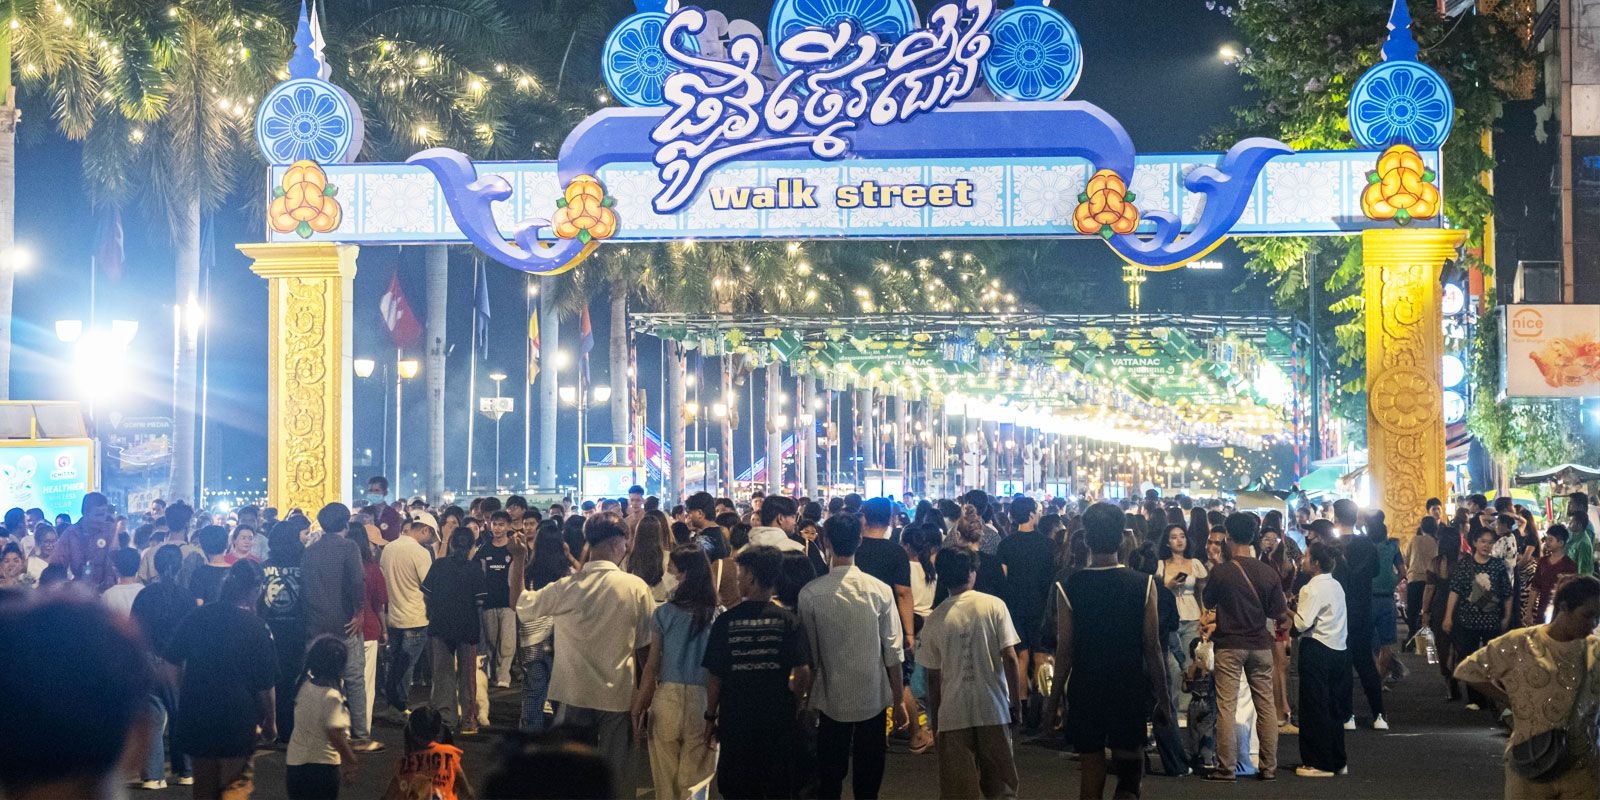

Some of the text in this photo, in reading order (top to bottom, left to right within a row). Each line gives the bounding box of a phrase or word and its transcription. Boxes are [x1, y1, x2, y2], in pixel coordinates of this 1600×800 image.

[711, 178, 974, 210] walk street
[1512, 316, 1544, 329] nice
[1111, 358, 1160, 366] VATTANAC
[731, 661, 782, 671] INNOVATION
